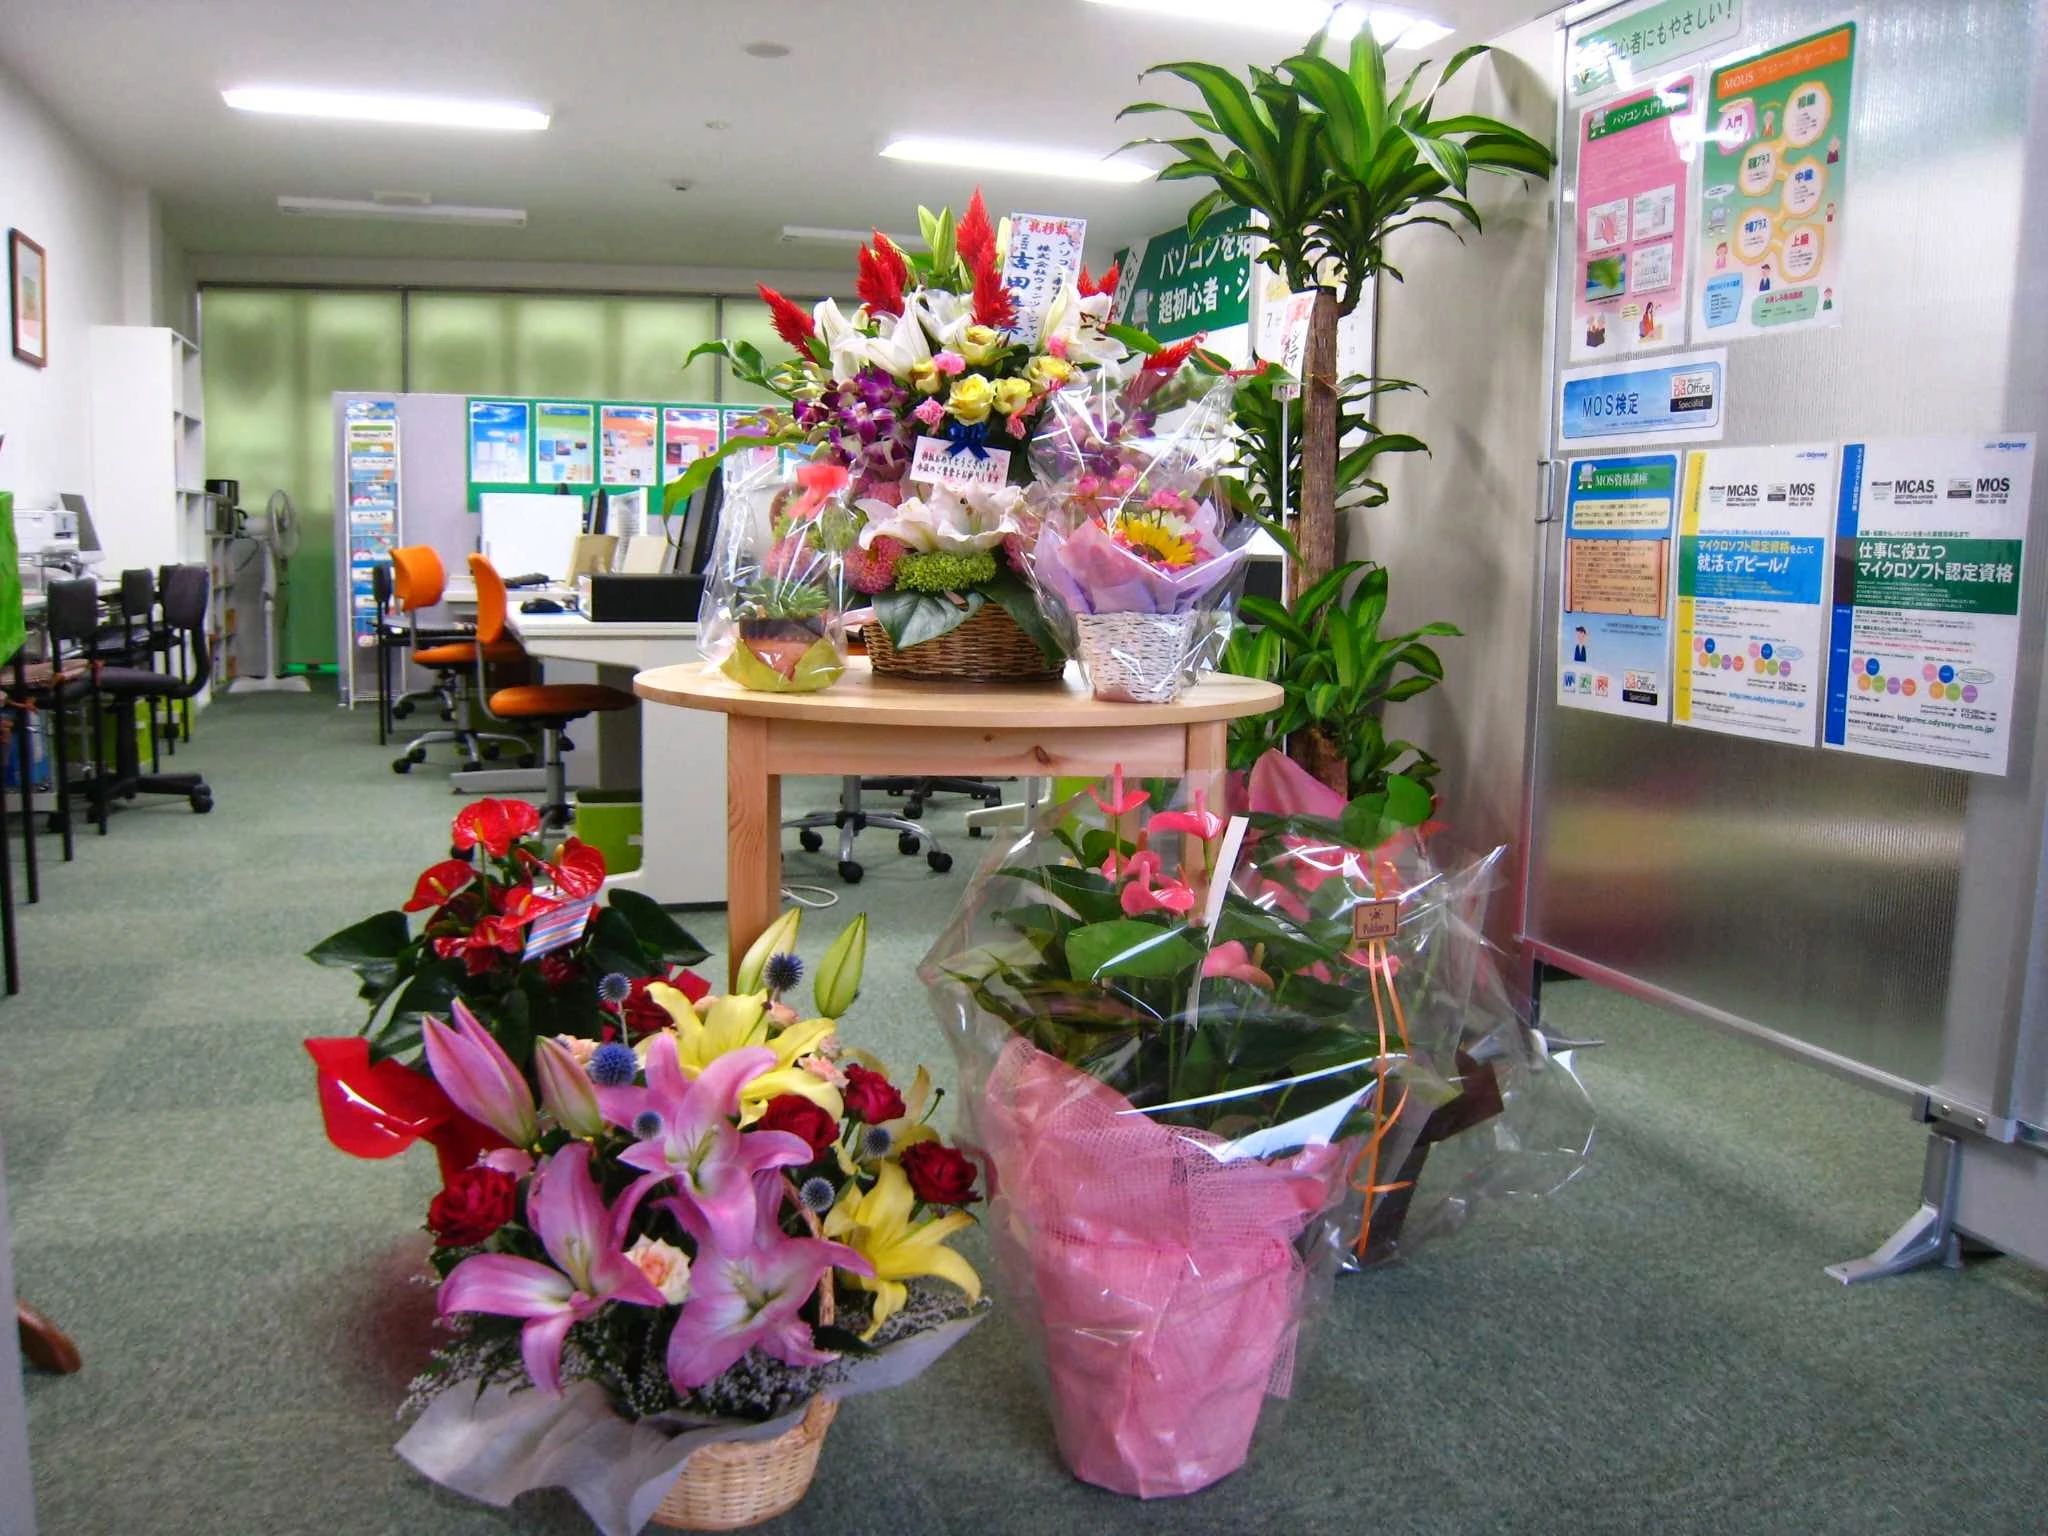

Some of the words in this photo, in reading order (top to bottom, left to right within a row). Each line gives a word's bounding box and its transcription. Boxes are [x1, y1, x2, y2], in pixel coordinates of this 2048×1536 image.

[1726, 115, 1743, 129] 入門
[1795, 168, 1814, 183] 中級
[1791, 233, 1809, 248] 上級
[1687, 383, 1711, 395] Office
[1582, 393, 1639, 418] MOS検定
[1727, 484, 1759, 497] MCAS
[1789, 483, 1815, 496] MOS
[1894, 479, 1935, 493] MCAS
[1976, 477, 2010, 492] MOS
[1858, 542, 1946, 561] 仕事に役立つ
[1696, 553, 1790, 575] 就活でアピール!
[1857, 561, 2014, 584] マイクロソフト認定資格
